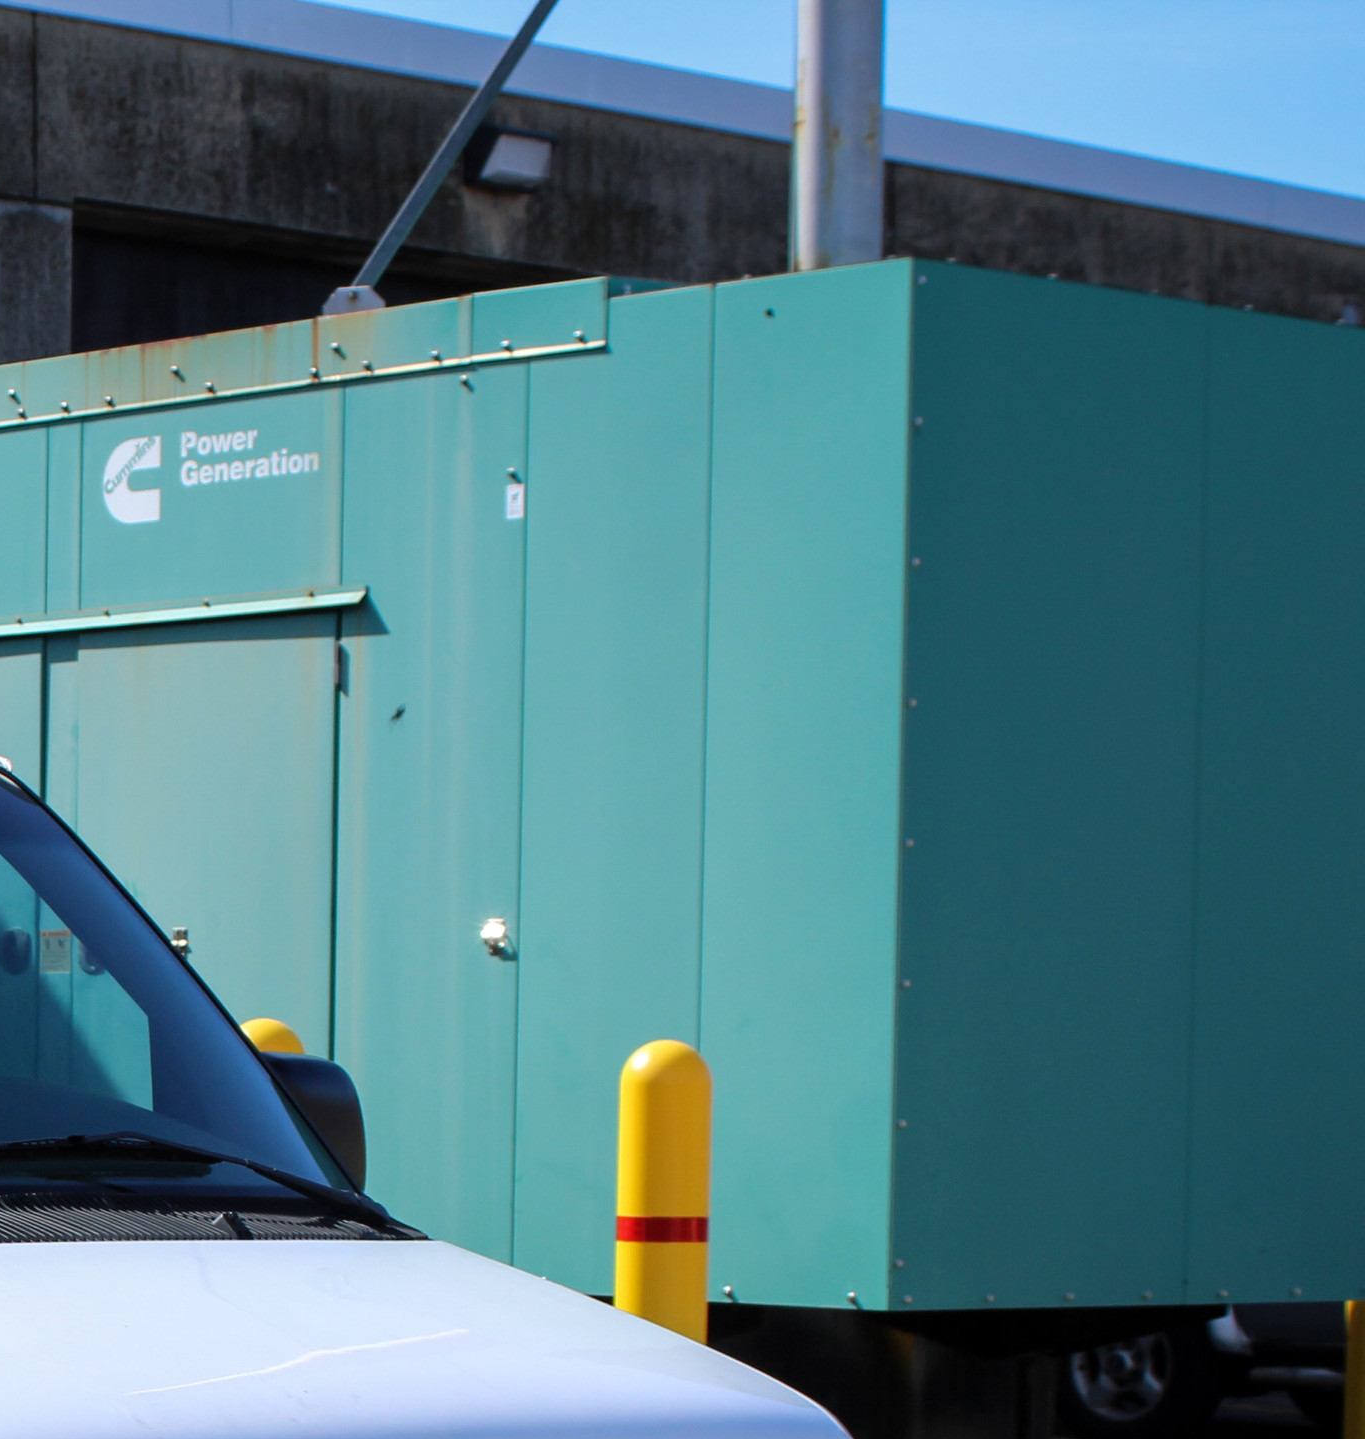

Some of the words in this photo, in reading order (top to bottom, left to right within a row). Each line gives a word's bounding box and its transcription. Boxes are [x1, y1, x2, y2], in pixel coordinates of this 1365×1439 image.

[180, 430, 257, 458] Power
[105, 437, 157, 494] Cummins
[180, 449, 320, 488] Generation
